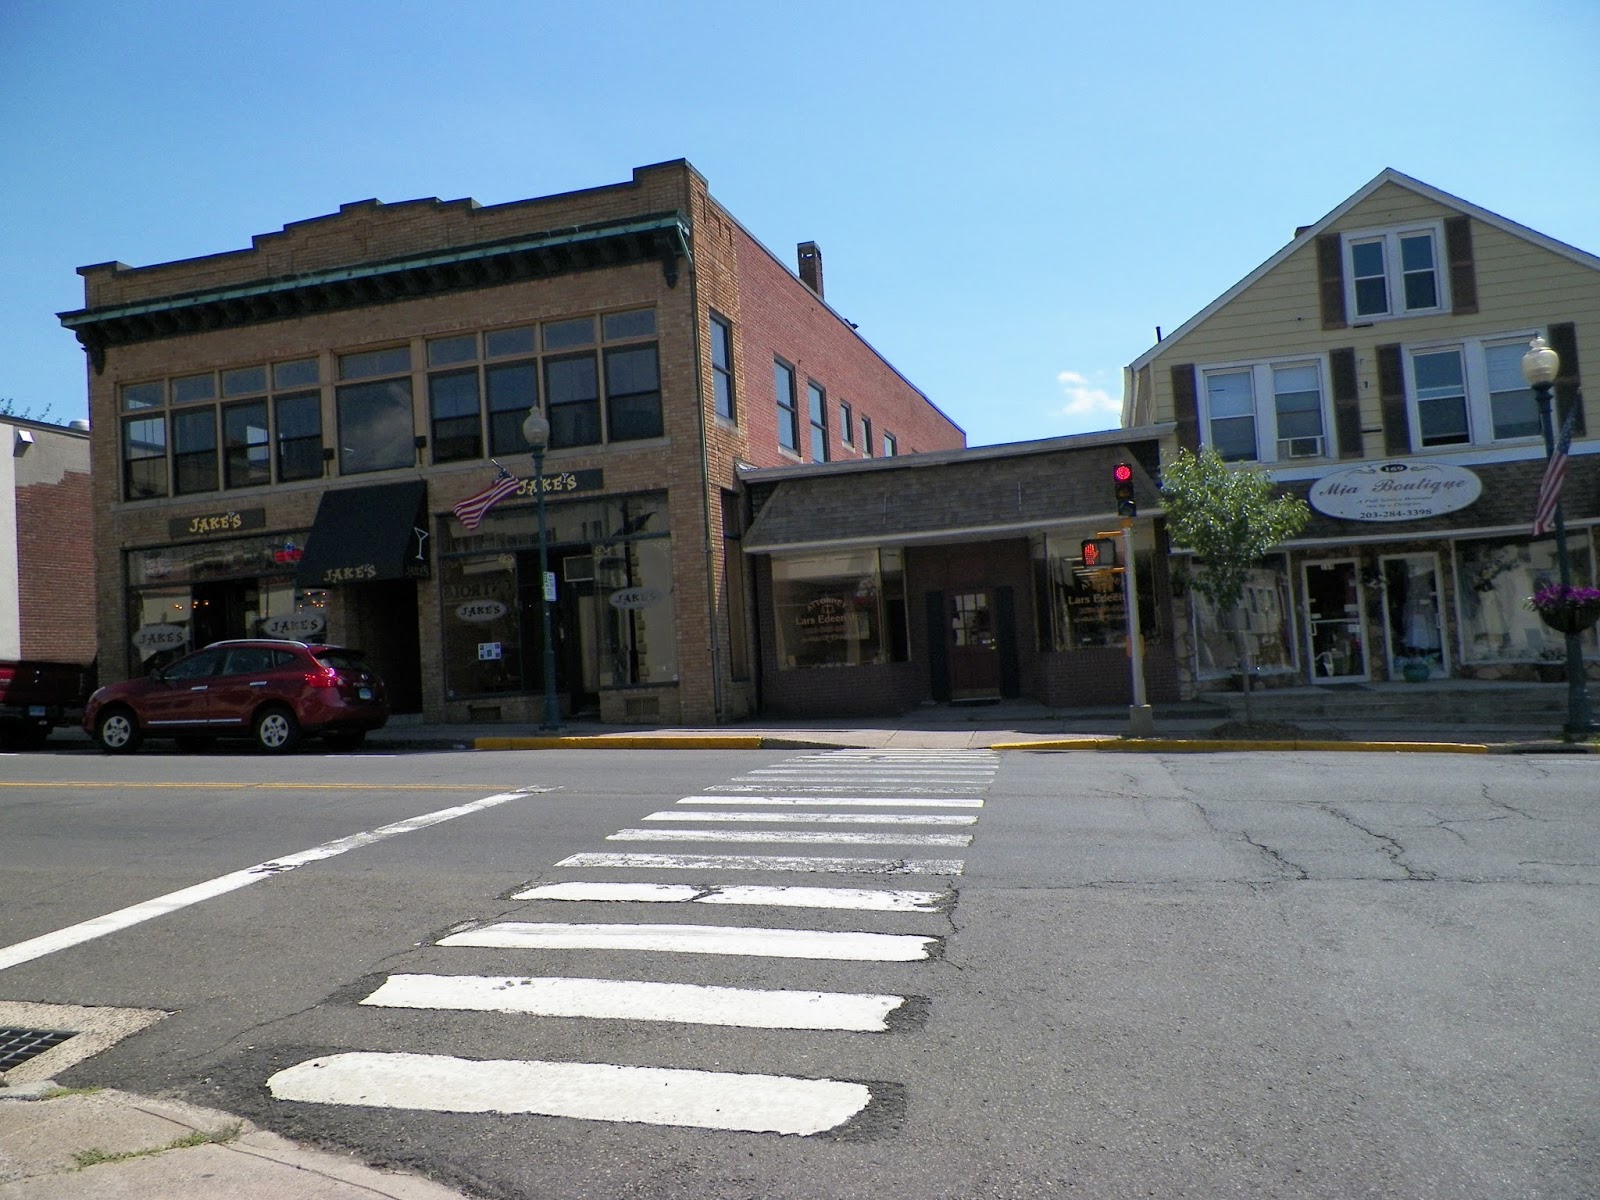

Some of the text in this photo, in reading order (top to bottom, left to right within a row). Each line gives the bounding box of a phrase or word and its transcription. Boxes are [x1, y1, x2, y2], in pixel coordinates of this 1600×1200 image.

[1385, 463, 1404, 472] 169
[1319, 478, 1467, 497] Mia Boutique
[1359, 508, 1432, 519] 203-284-3398
[1067, 596, 1090, 605] Lars
[795, 616, 815, 625] Lars
[817, 614, 847, 624] Edeen
